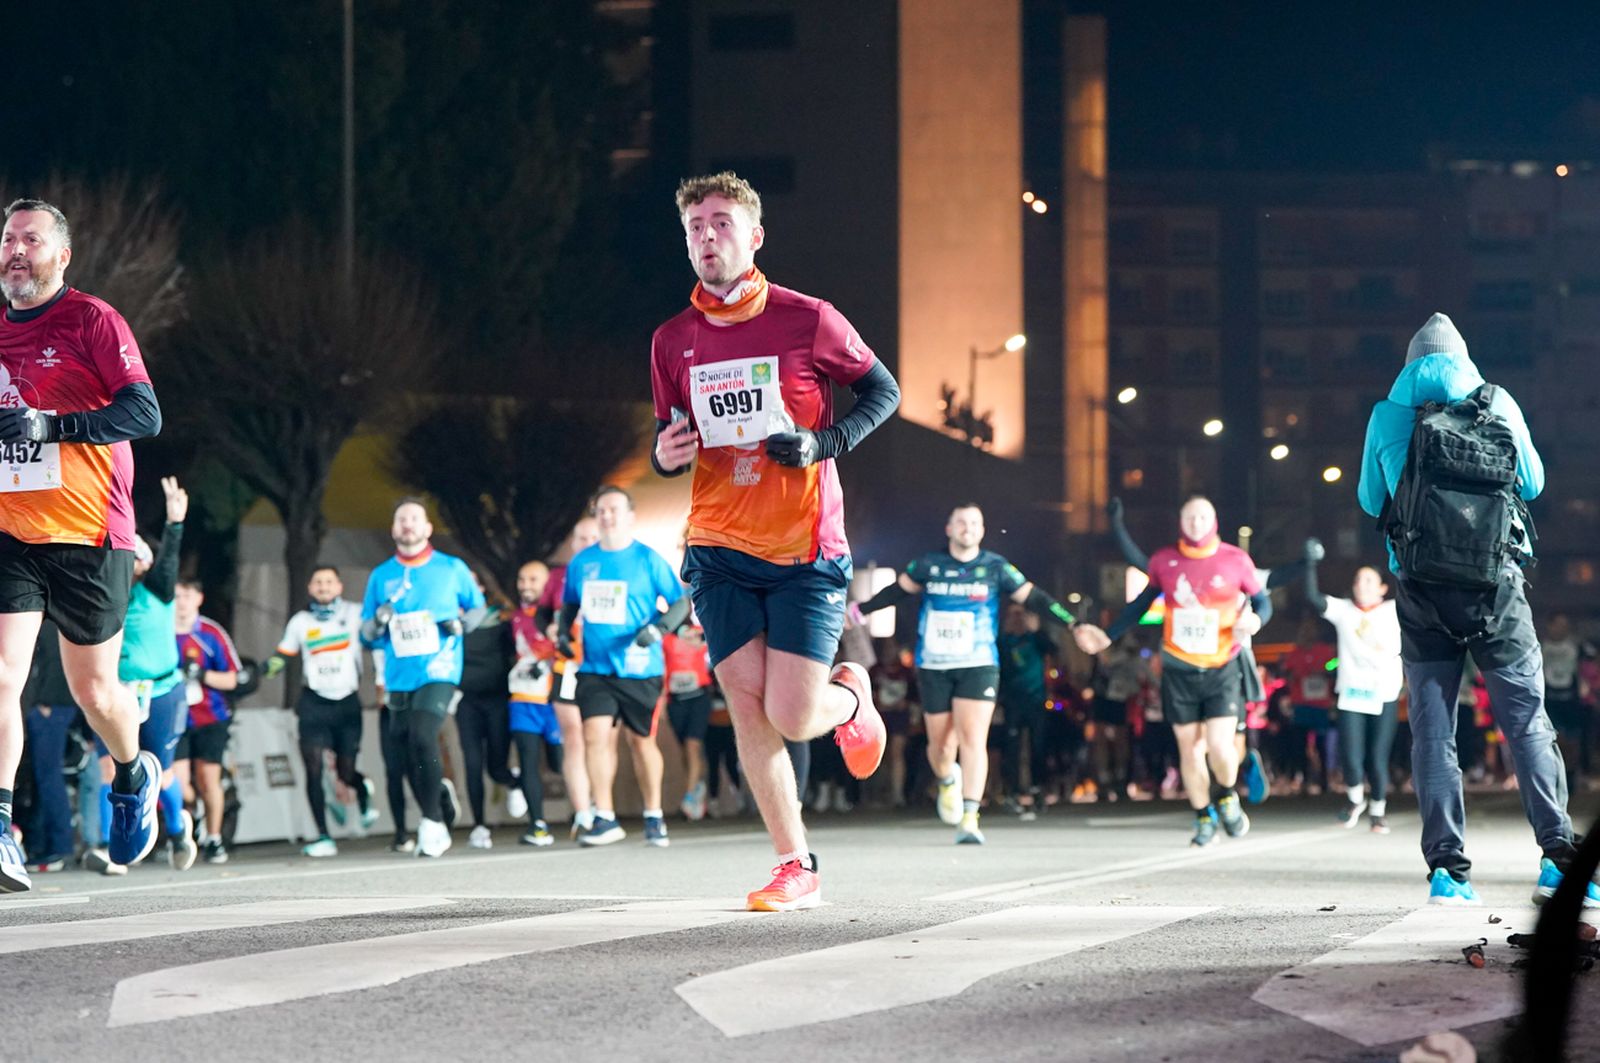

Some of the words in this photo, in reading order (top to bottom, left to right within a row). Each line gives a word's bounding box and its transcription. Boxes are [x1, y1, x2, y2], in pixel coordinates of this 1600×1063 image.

[708, 371, 731, 382] NOCHE
[734, 369, 743, 379] DE
[699, 383, 716, 394] SAN
[709, 388, 763, 418] 6997
[0, 440, 42, 464] 452
[926, 582, 949, 595] SAN
